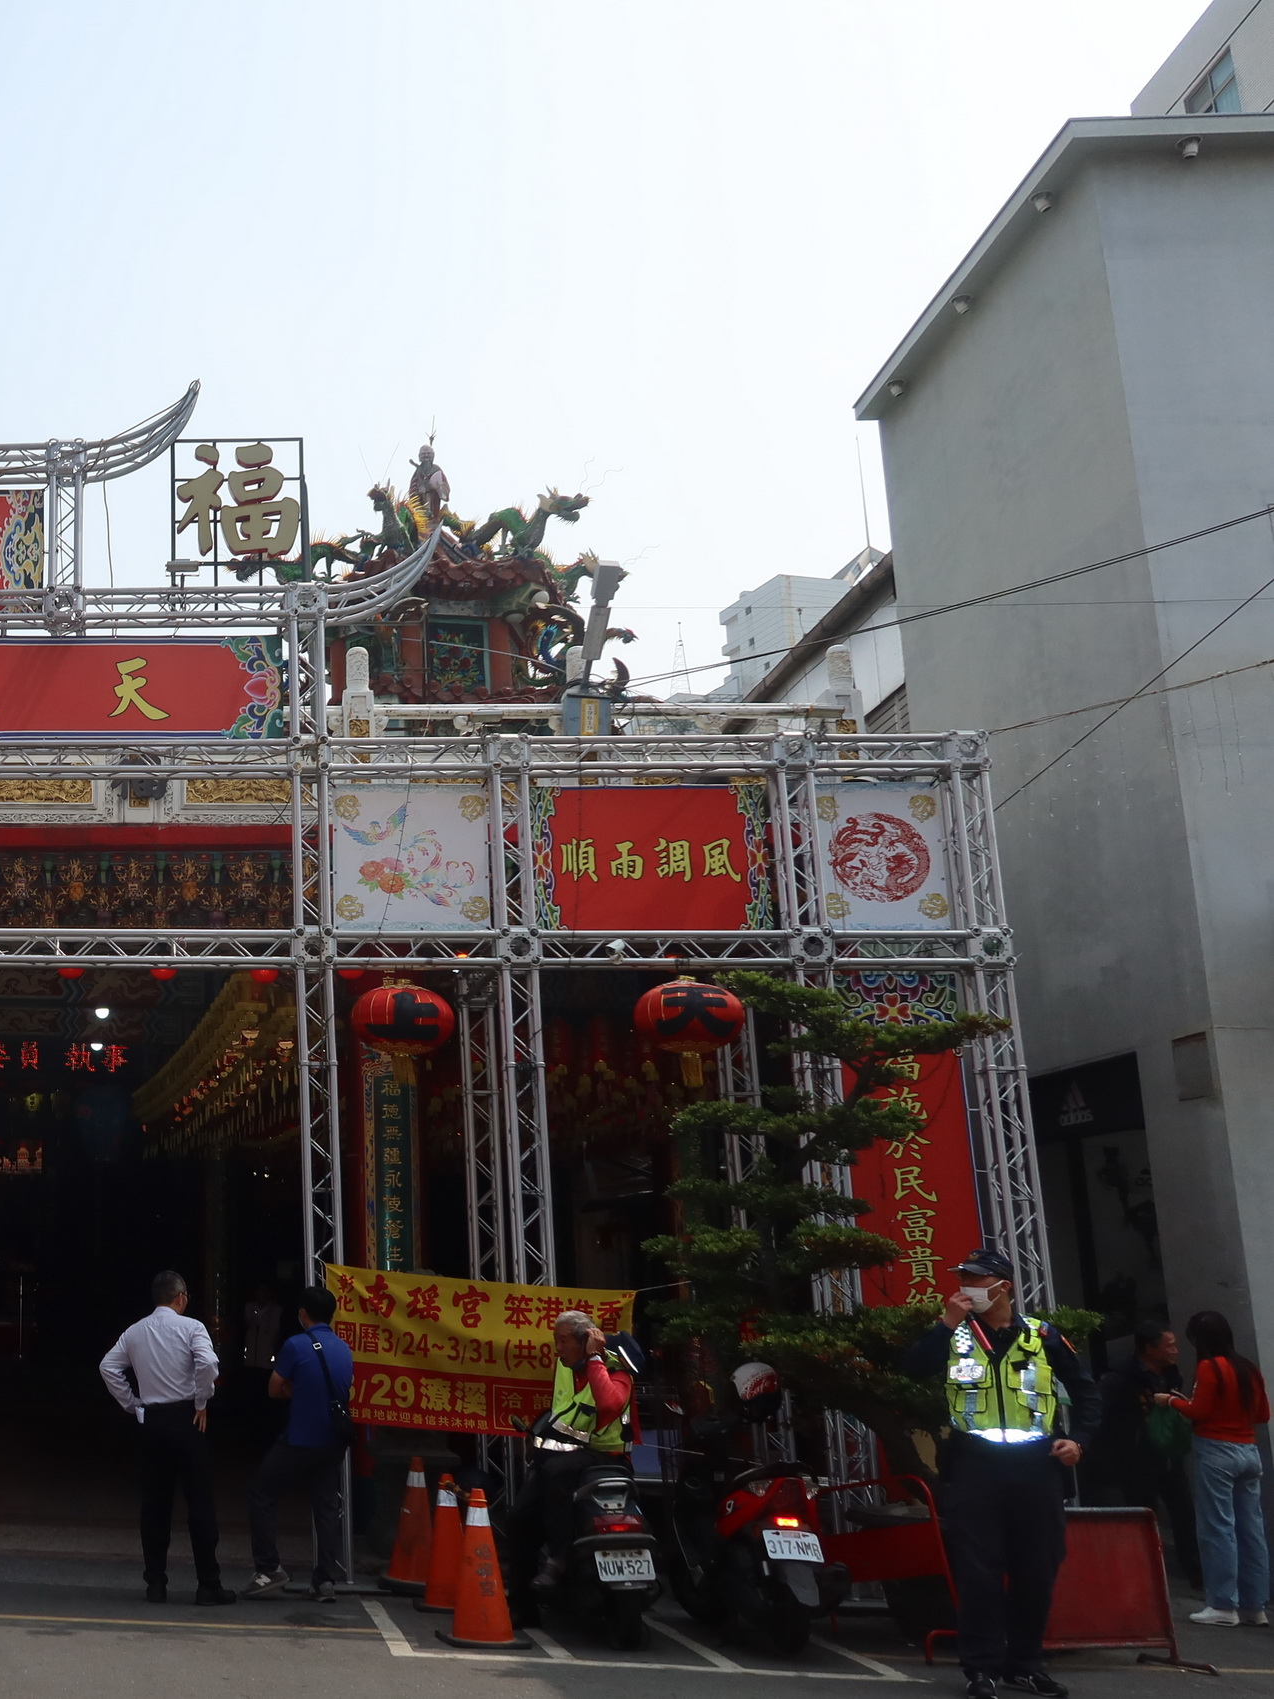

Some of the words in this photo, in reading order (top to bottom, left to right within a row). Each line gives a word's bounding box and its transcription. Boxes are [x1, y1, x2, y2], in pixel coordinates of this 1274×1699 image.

[176, 444, 300, 559] 福
[365, 991, 440, 1041] 上
[657, 986, 737, 1037] 天
[1059, 1108, 1094, 1127] adidas
